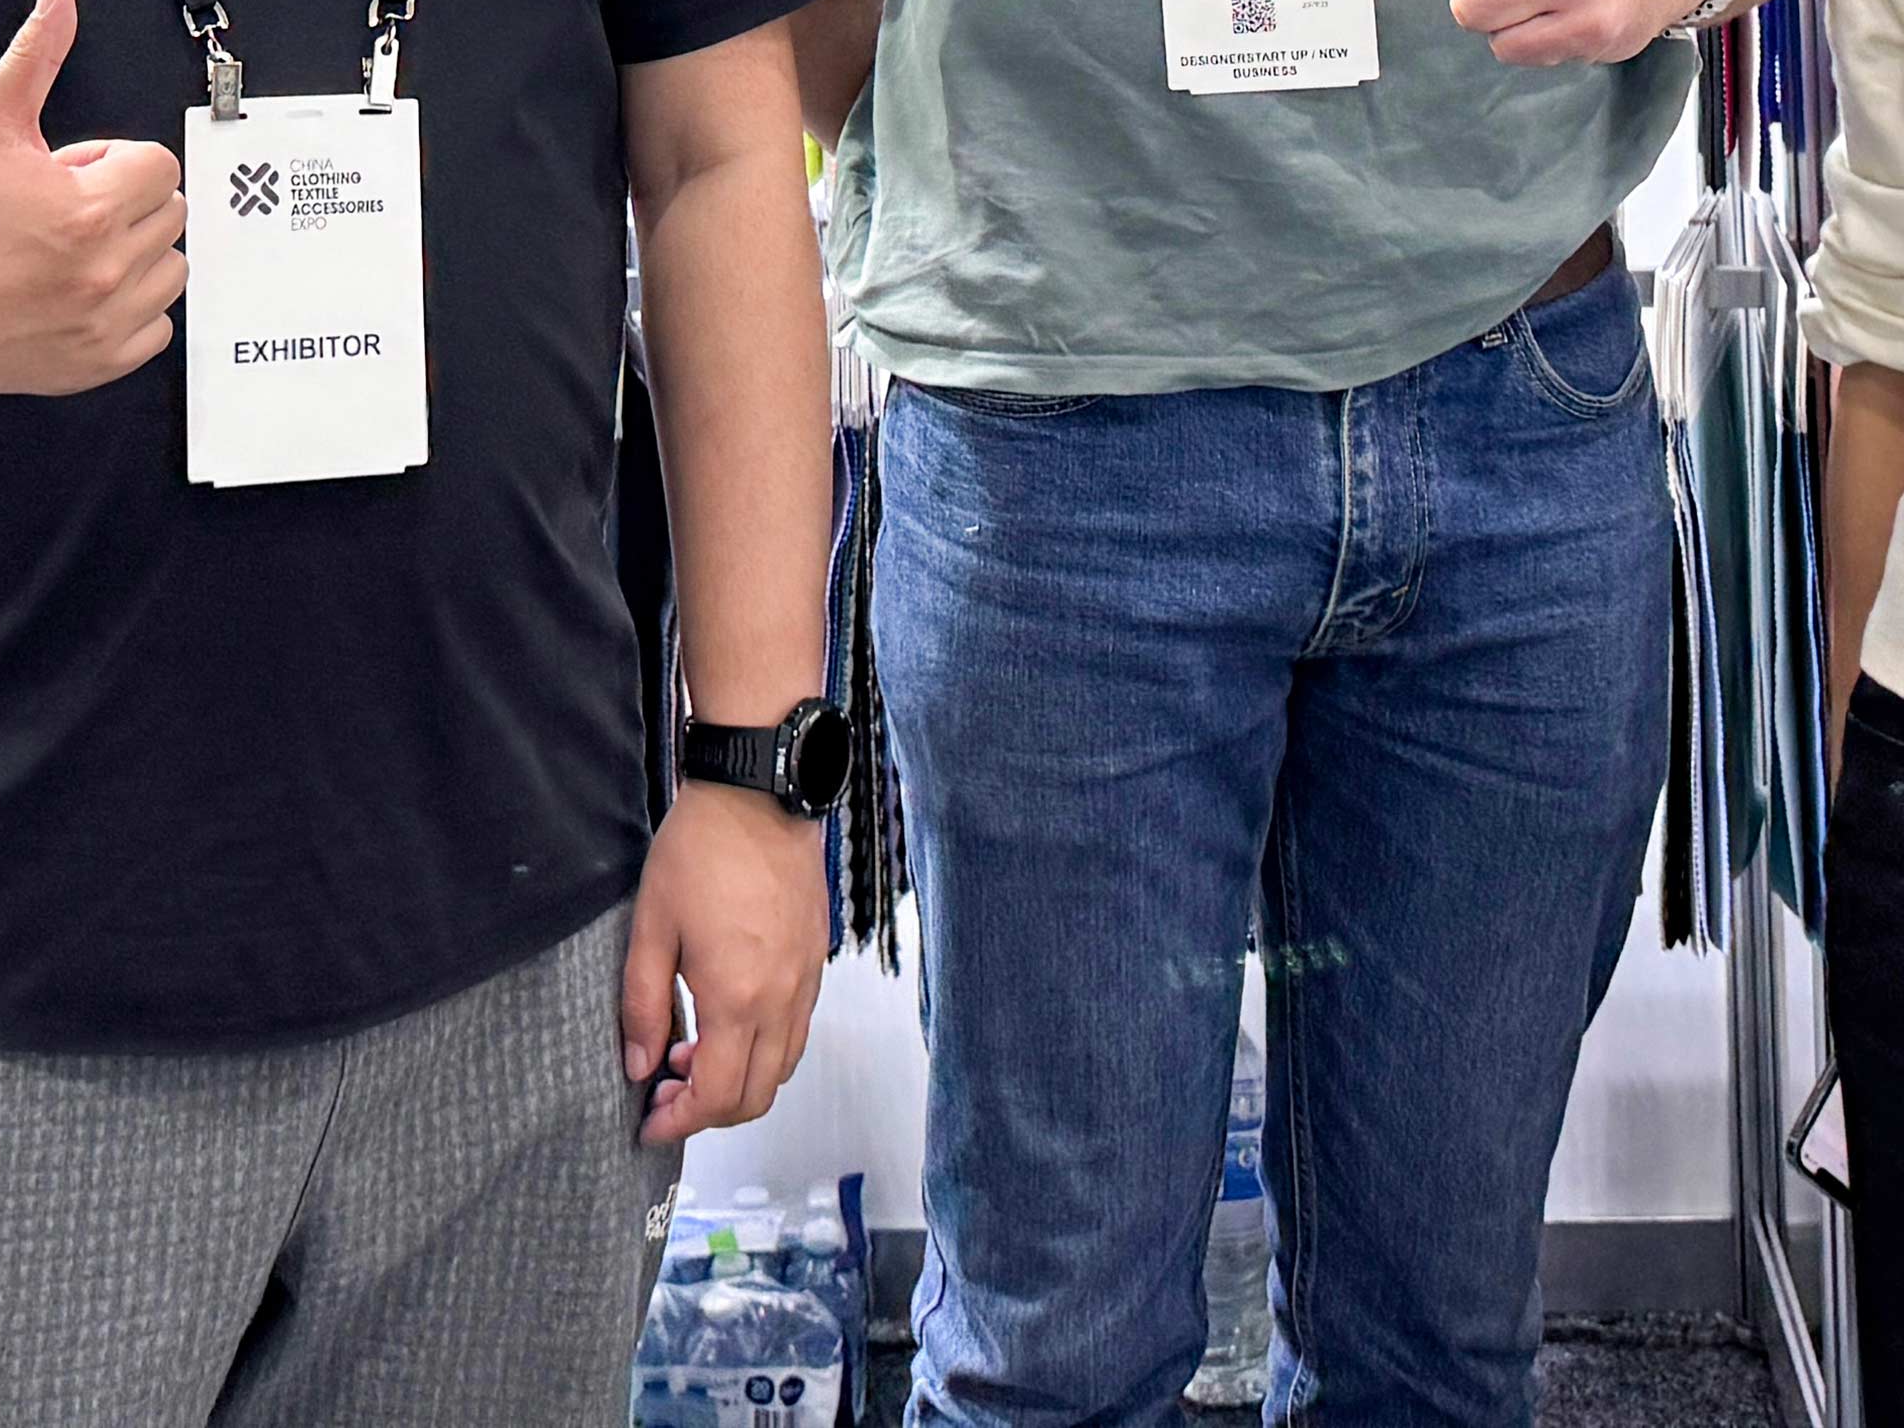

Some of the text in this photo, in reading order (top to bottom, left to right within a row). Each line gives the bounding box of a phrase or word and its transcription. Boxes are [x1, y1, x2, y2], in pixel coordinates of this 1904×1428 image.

[289, 158, 334, 173] CHINA
[290, 171, 362, 186] CLOTHING
[290, 185, 339, 201] TEXTILE
[290, 199, 384, 217] ACCESSORIES
[290, 216, 327, 231] EXPO
[234, 333, 381, 364] EXHIBITOR
